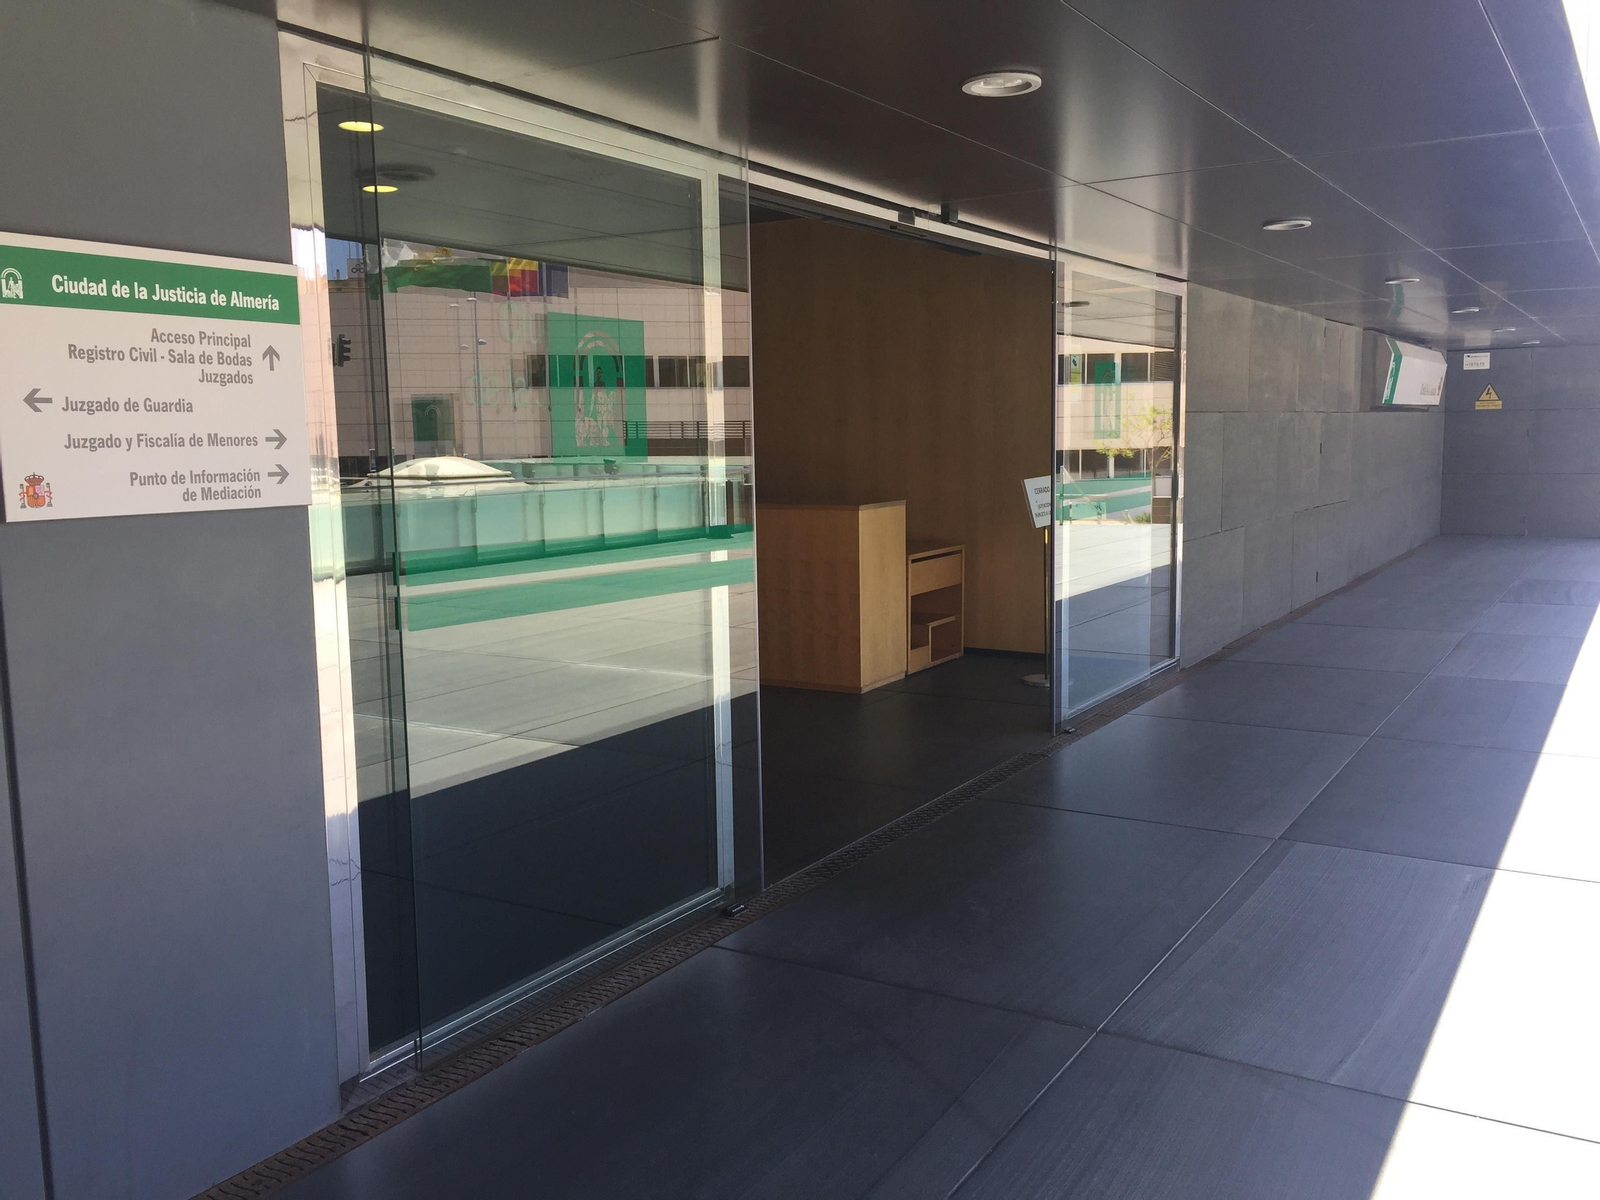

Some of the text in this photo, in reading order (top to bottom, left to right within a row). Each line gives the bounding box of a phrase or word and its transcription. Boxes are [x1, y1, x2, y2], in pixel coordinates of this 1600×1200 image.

[51, 274, 280, 310] Ciudad de la Justicia de Almería
[150, 328, 251, 348] Acceso Principal
[68, 344, 125, 363] Registro
[129, 347, 157, 362] Civil
[168, 350, 195, 364] Sala
[199, 351, 214, 365] de
[217, 352, 252, 366] Bodas
[198, 369, 254, 386] Juzgados
[62, 397, 194, 415] Juzgado de Guardia
[64, 433, 258, 452] Juzgado y Fiscalía de Menores
[130, 468, 260, 487] Punto de Información
[182, 486, 261, 502] de Mediación
[1034, 486, 1050, 494] CERRADO
